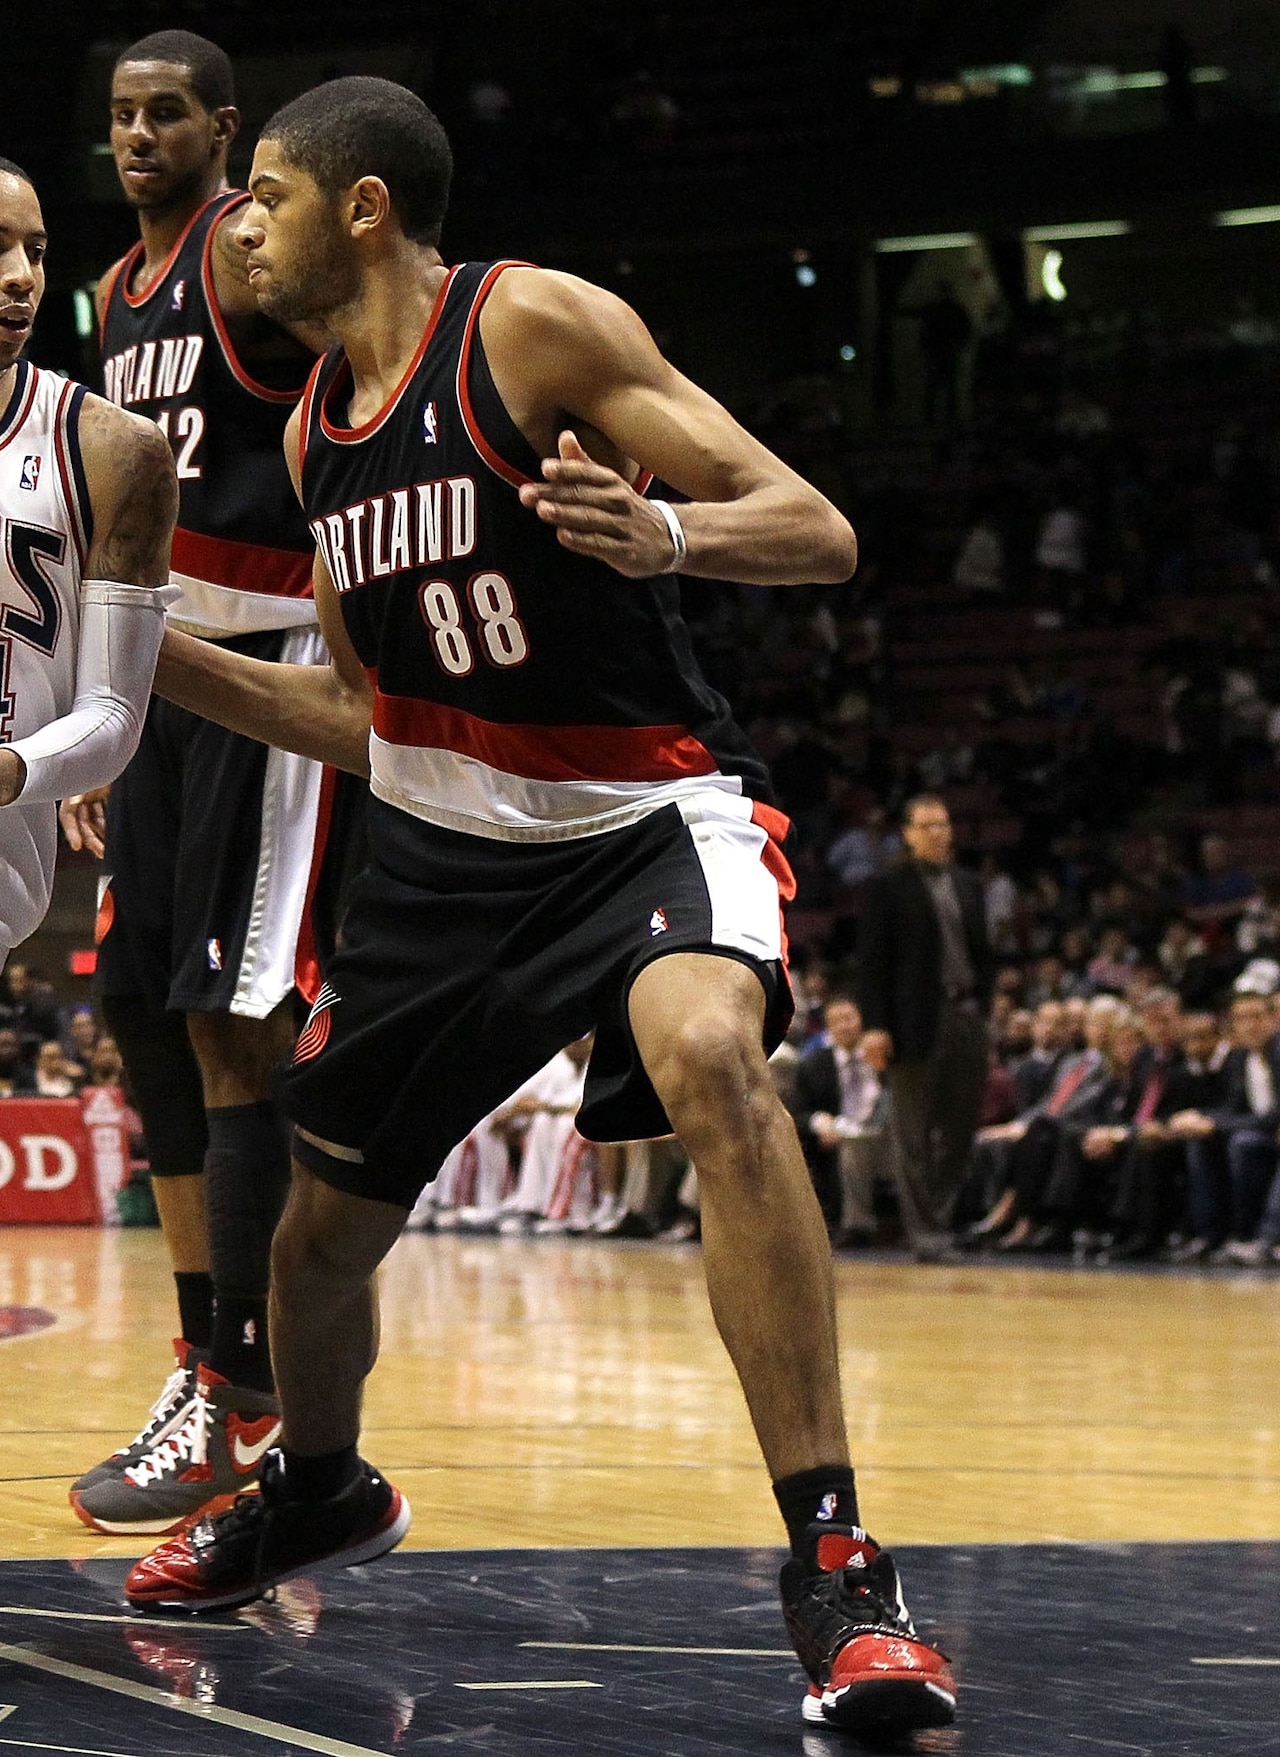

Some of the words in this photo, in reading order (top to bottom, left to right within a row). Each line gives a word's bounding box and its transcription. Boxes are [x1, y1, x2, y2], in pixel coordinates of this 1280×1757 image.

[104, 335, 204, 408] ORTLAND
[309, 476, 477, 593] ORTLAND
[419, 571, 530, 677] 88
